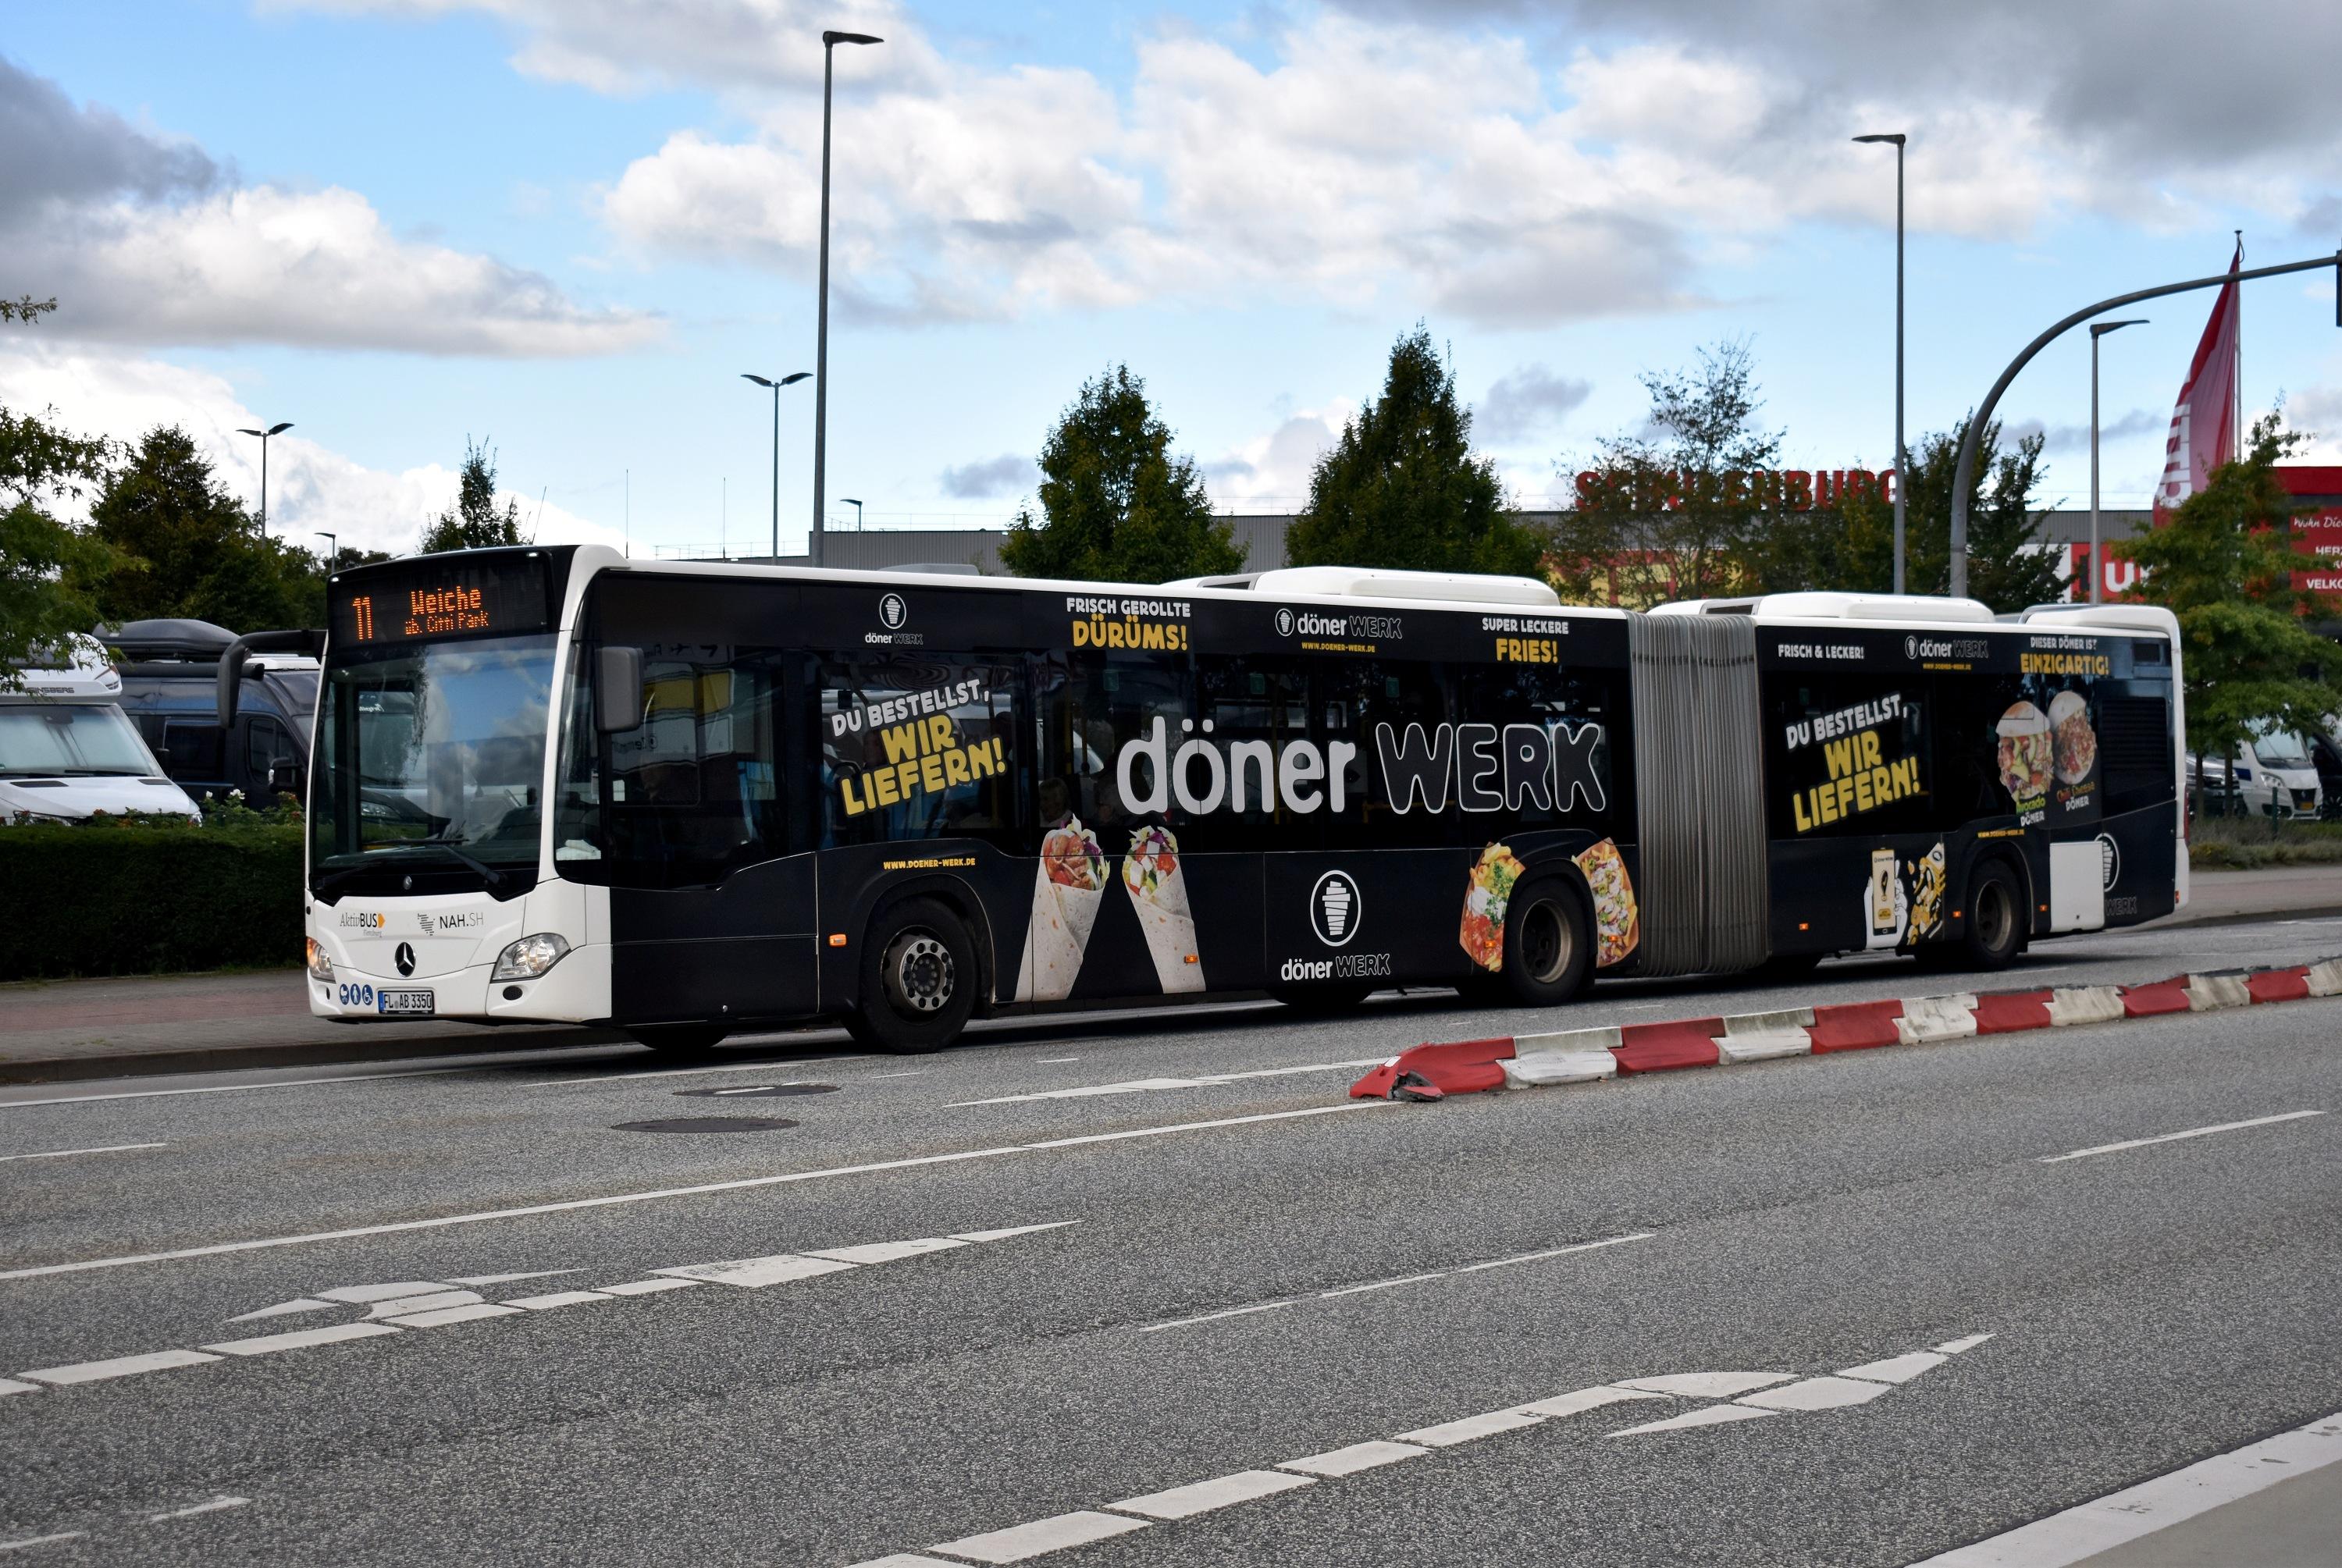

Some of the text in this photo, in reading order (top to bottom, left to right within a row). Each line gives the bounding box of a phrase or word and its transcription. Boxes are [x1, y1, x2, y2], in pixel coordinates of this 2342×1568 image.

[2323, 517, 2342, 528] Dic
[411, 585, 482, 615] Weiche
[1066, 597, 1191, 617] FRISCH GEROLLTE
[353, 596, 372, 640] 11
[427, 613, 454, 631] Citti
[458, 610, 489, 629] Park
[1297, 613, 1403, 639] döner WERK
[1482, 617, 1569, 635] SUPER LECKERE
[865, 632, 924, 645] döner WERK
[1073, 613, 1188, 651] DÜRÜMS!
[2031, 636, 2057, 649] DIESER
[2059, 635, 2084, 649] DÖNER
[1301, 642, 1376, 653] WWW.DOENER-WERK.DE
[1496, 638, 1558, 663] FRIES!
[1778, 644, 1864, 660] FRISCH & LECKER!
[1920, 639, 1989, 659] döner WERK
[2020, 652, 2109, 675] EINZIGARTIG!
[831, 679, 989, 737] DU BESTELLST,
[1785, 693, 1907, 749] DU BESTELLST,
[881, 714, 956, 765] WIR
[1116, 716, 1606, 816] döner WERK
[1824, 731, 1881, 780] WIR
[840, 738, 1006, 816] LIEFERN!
[1793, 756, 1920, 832] LIEFERN!
[2066, 796, 2090, 812] DÖNER
[2020, 811, 2045, 827] DÖNER
[883, 857, 976, 870] WWW.DOENER-WERK.DE
[340, 912, 378, 929] AktivBUS
[440, 912, 484, 929] NAH.SH
[1281, 953, 1391, 981] döner WERK
[384, 994, 432, 1008] FL AB 3350
